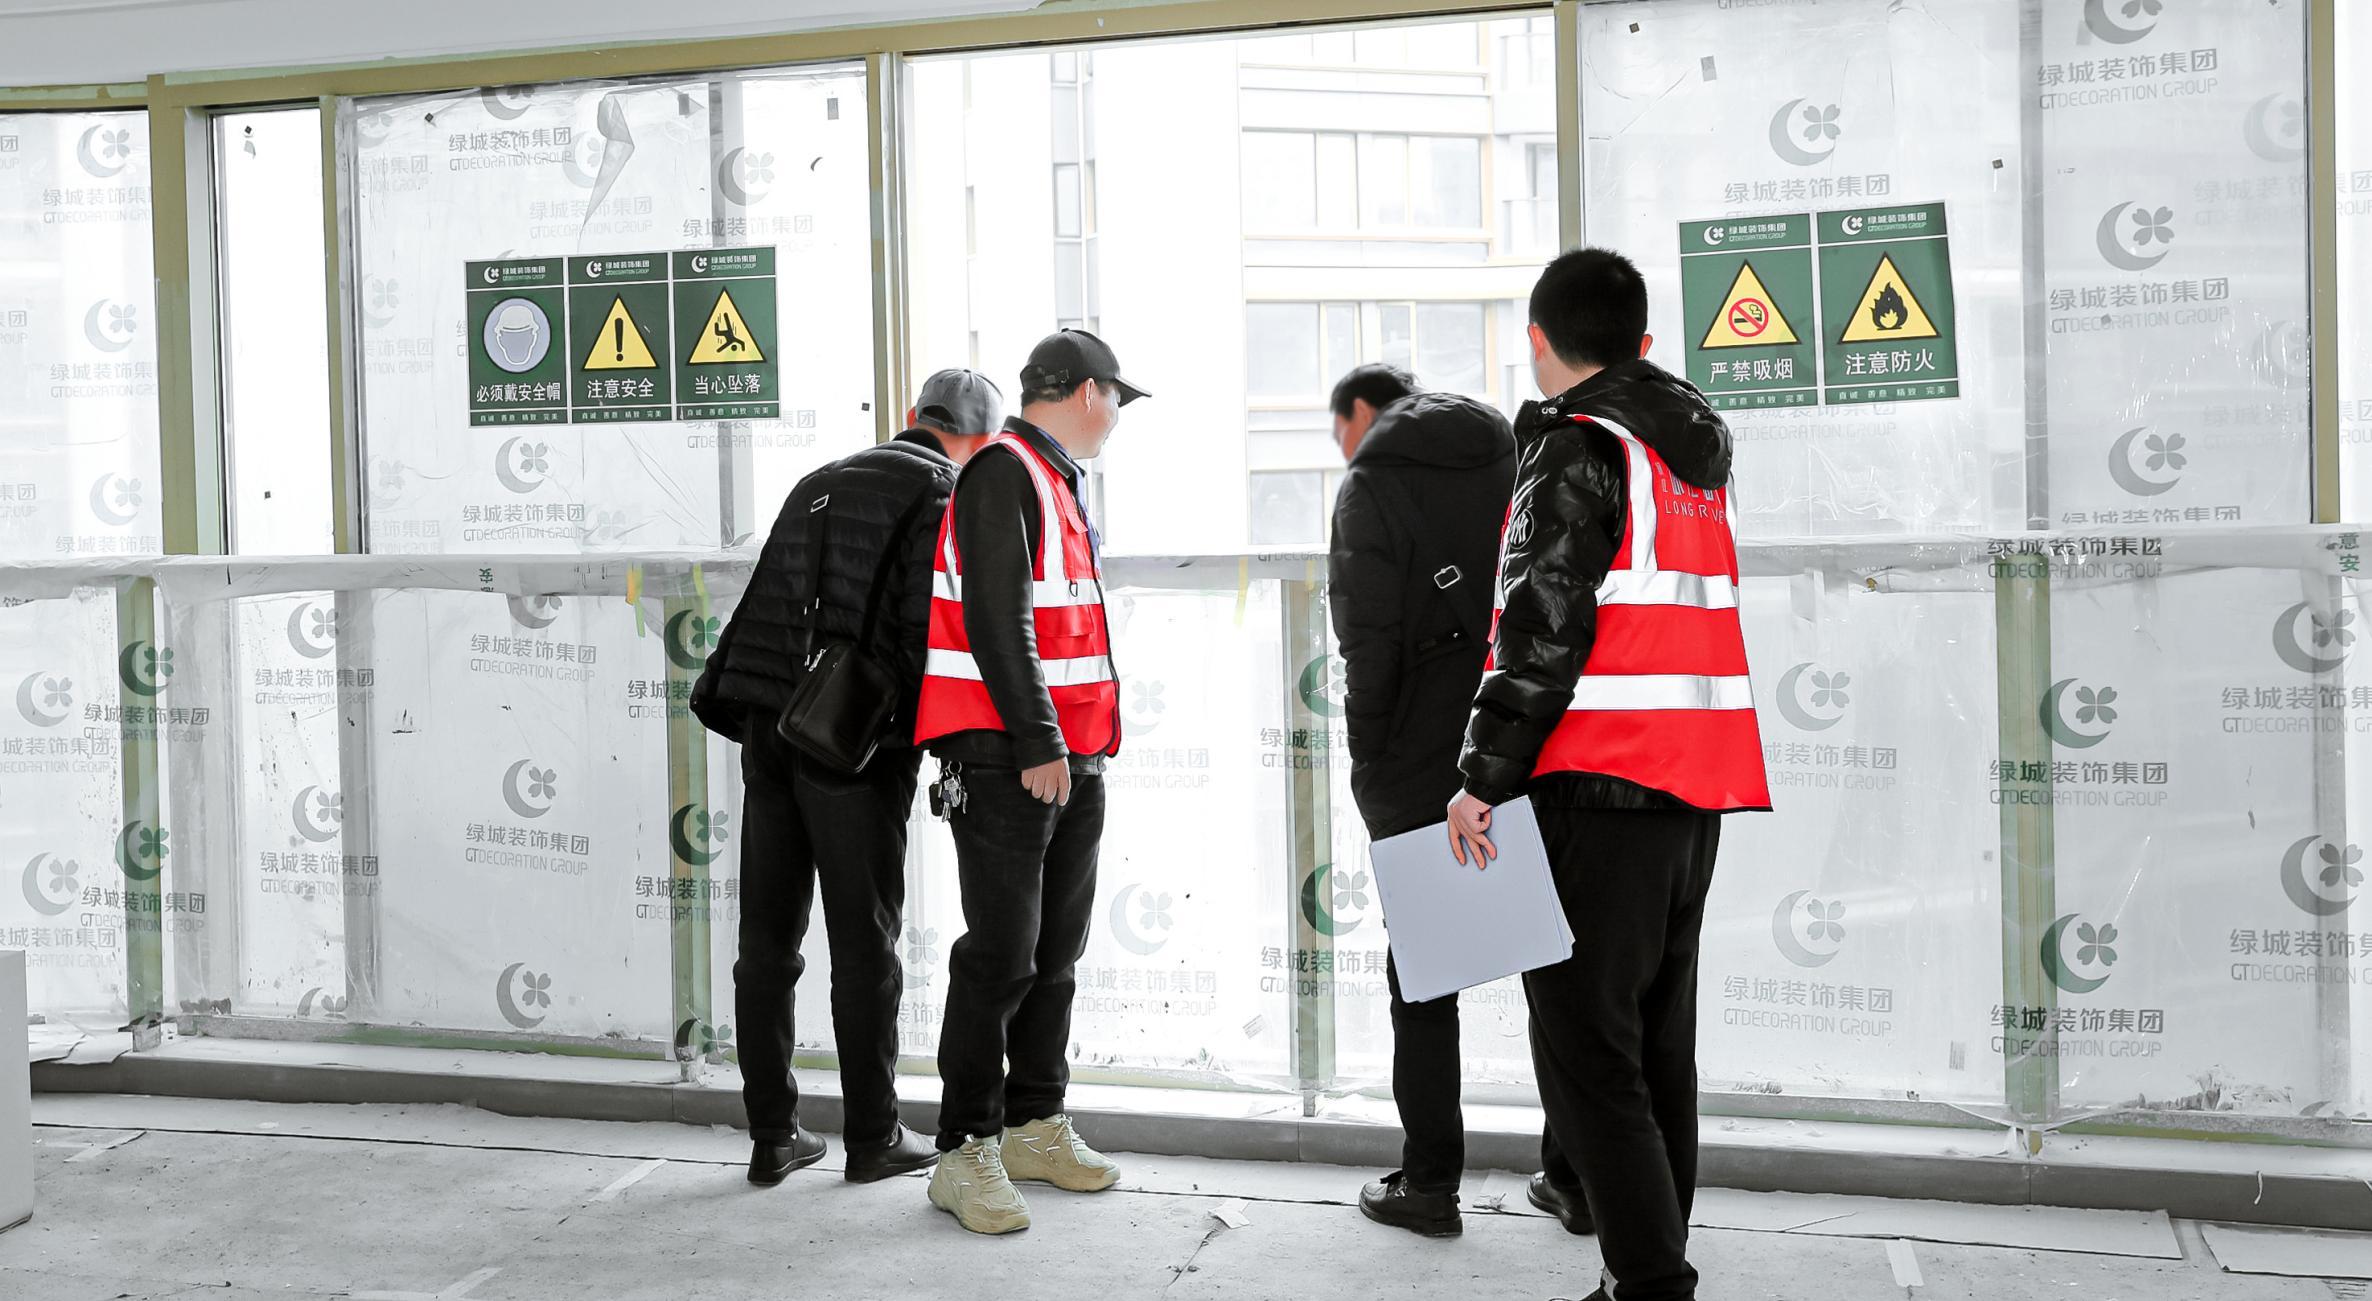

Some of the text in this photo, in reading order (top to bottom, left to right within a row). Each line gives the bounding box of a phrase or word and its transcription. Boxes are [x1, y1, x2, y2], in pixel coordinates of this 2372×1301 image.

[2037, 48, 2218, 87] 绿城装饰集团
[2039, 78, 2218, 110] GTDECORATION GROUP
[449, 127, 572, 152] 绿城装饰集团
[43, 187, 153, 208] 绿城装饰集
[1724, 174, 1891, 204] 绿城装饰集团
[2050, 277, 2229, 311] 绿城装饰集团
[2051, 306, 2230, 334] GTDECORATION GROUP
[50, 361, 155, 381] 绿城装饰集
[1709, 357, 1793, 384] 严禁吸烟
[1845, 348, 1936, 376] 注意防火
[476, 381, 561, 402] 必须戴安全帽
[587, 377, 655, 399] 注意安全
[695, 374, 761, 395] 当心坠落
[463, 503, 585, 523] 绿城装饰集团
[1665, 500, 1694, 517] LONG
[56, 535, 157, 554] 绿城装饰集
[463, 528, 545, 542] GTDECORATION
[470, 633, 597, 665] 绿城装饰集团
[255, 667, 375, 689] 绿城装饰集团
[470, 658, 596, 682] GTDECORATION GROUP
[627, 680, 690, 700] 绿城装
[2222, 686, 2372, 710] 绿城装饰集
[84, 703, 210, 726] 绿城装饰集团
[2222, 716, 2348, 733] GTDECORATION
[0, 737, 110, 756] 城装饰集团
[1115, 747, 1210, 769] 装饰集团
[1763, 742, 1897, 770] 城装饰集团
[0, 761, 70, 774] DECORATION
[1261, 753, 1349, 770] GTDECORATIO
[1989, 759, 2168, 785] 绿城装饰集团
[1105, 774, 1210, 790] ORATION GROUP
[1844, 773, 1896, 792] GROUP
[1989, 788, 2168, 808] GTDECORATION GROUP
[465, 822, 590, 856] 绿城装饰集团
[260, 850, 380, 877] 绿城装饰集团
[465, 847, 589, 877] GTDECORATION GROUP
[635, 875, 740, 900] 绿城装饰集
[81, 885, 207, 914] 绿城装饰集团
[0, 926, 116, 949] 城装饰集团
[1260, 946, 1388, 975] 绿城装饰集
[2231, 963, 2356, 985] GTDECORATION
[1260, 976, 1361, 999] GTDECORATION
[1723, 975, 1893, 1013] 绿城装饰集团
[1723, 1007, 1893, 1038] GTDECORATION GROUP
[1990, 1003, 2164, 1034] 绿城装饰集团
